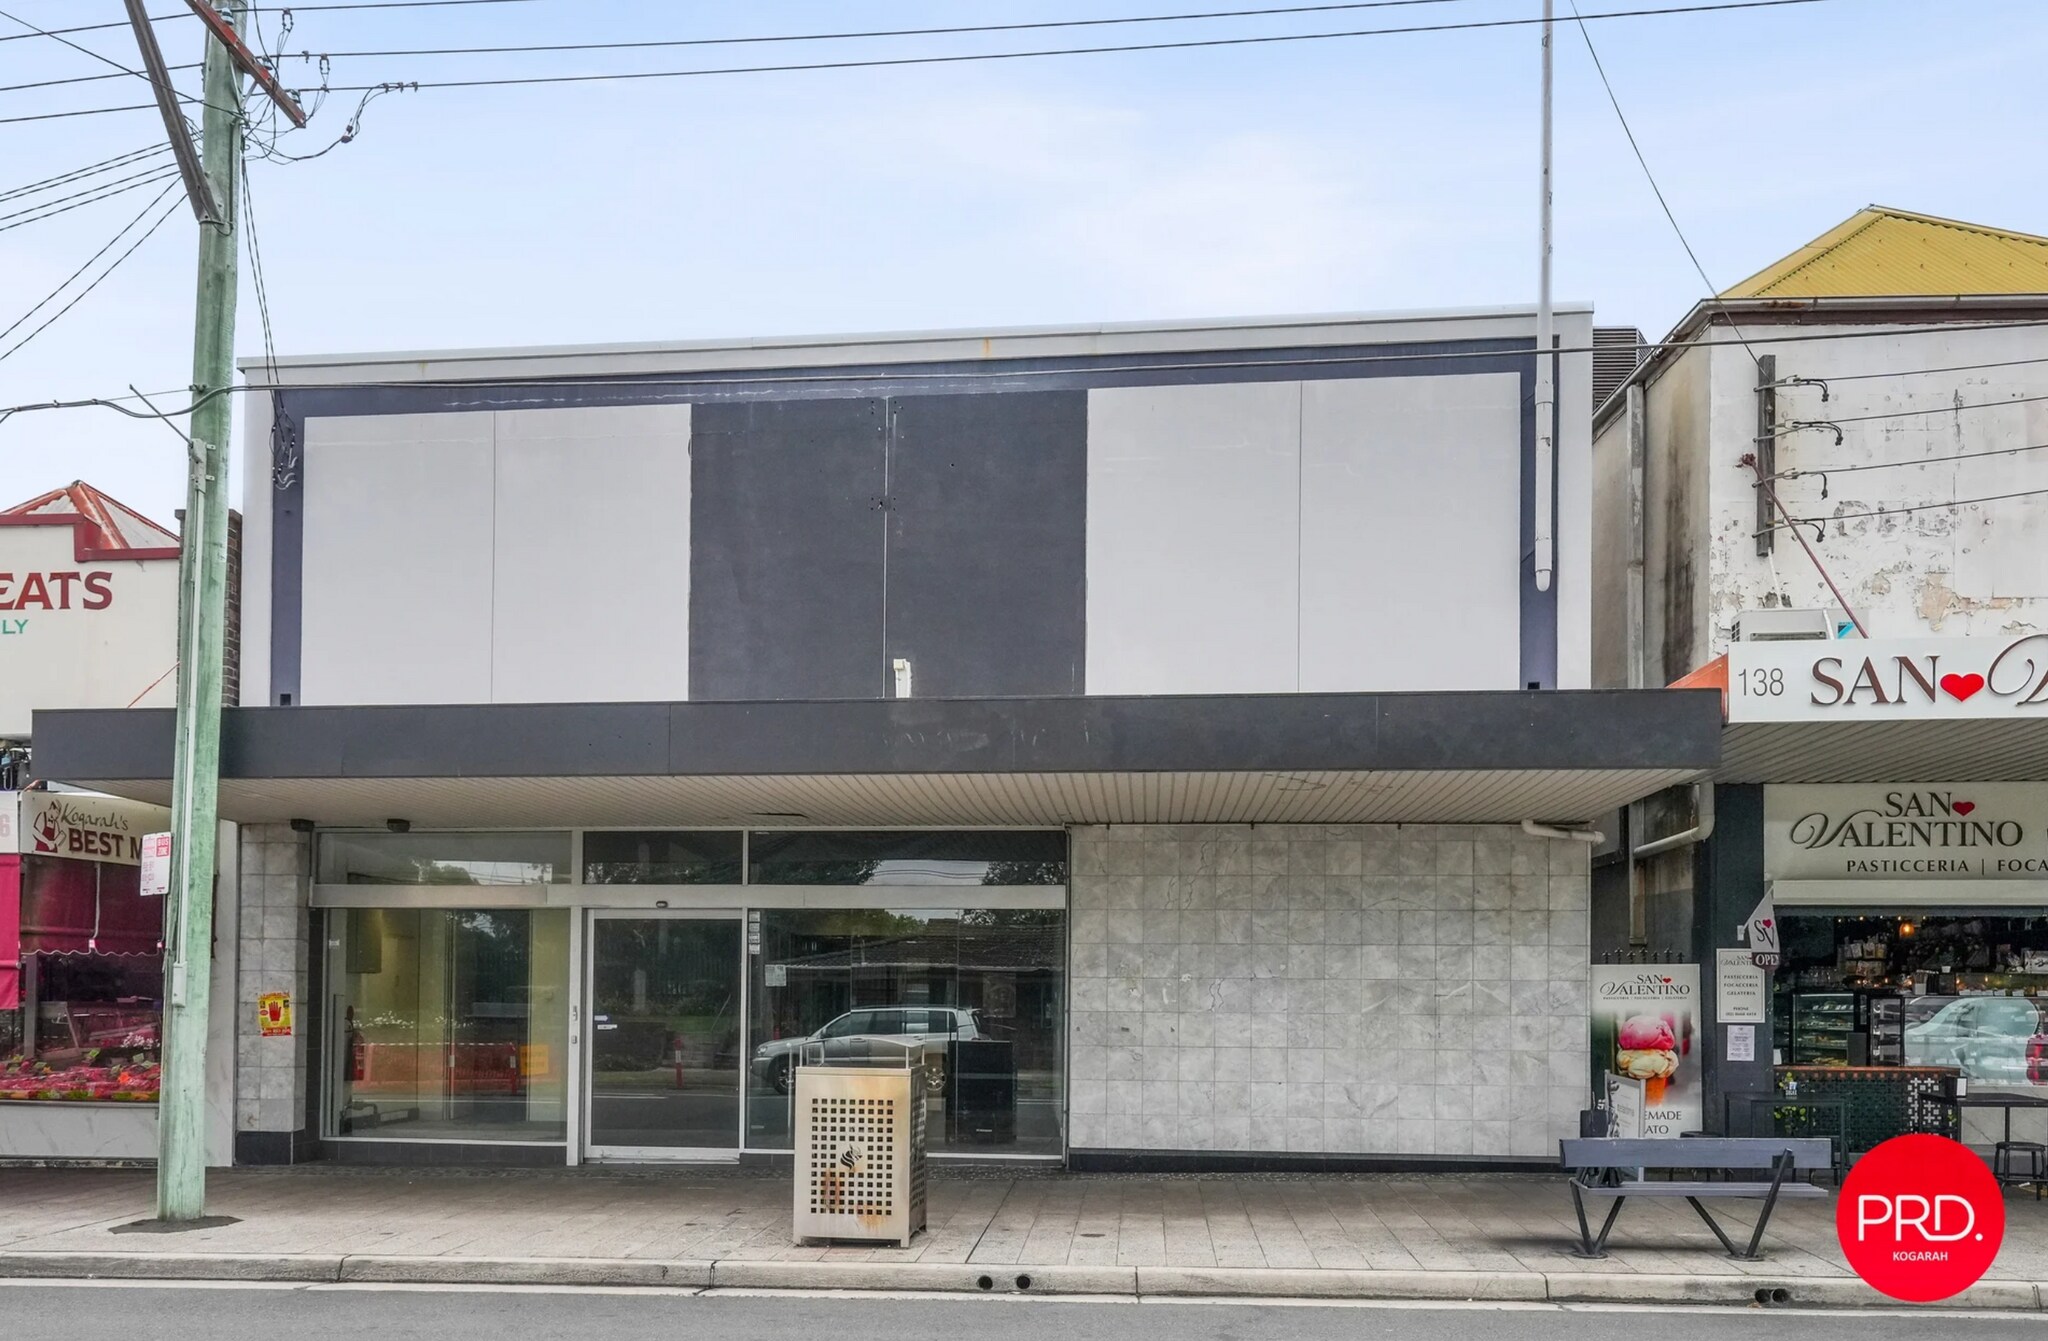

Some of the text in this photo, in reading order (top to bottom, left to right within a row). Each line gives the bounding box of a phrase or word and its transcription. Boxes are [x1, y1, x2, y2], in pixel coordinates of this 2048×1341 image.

[2, 619, 29, 634] LY
[1738, 668, 1785, 697] 138
[1810, 655, 1941, 706] SAN
[61, 803, 129, 832] Kogarah's
[1885, 792, 1952, 818] SAN
[68, 827, 124, 858] BEST
[1790, 809, 2024, 850] VALENTINO
[1847, 859, 1970, 873] PASTICCERIA
[1599, 981, 1691, 996] VALENTINO
[1636, 974, 1664, 985] SAN
